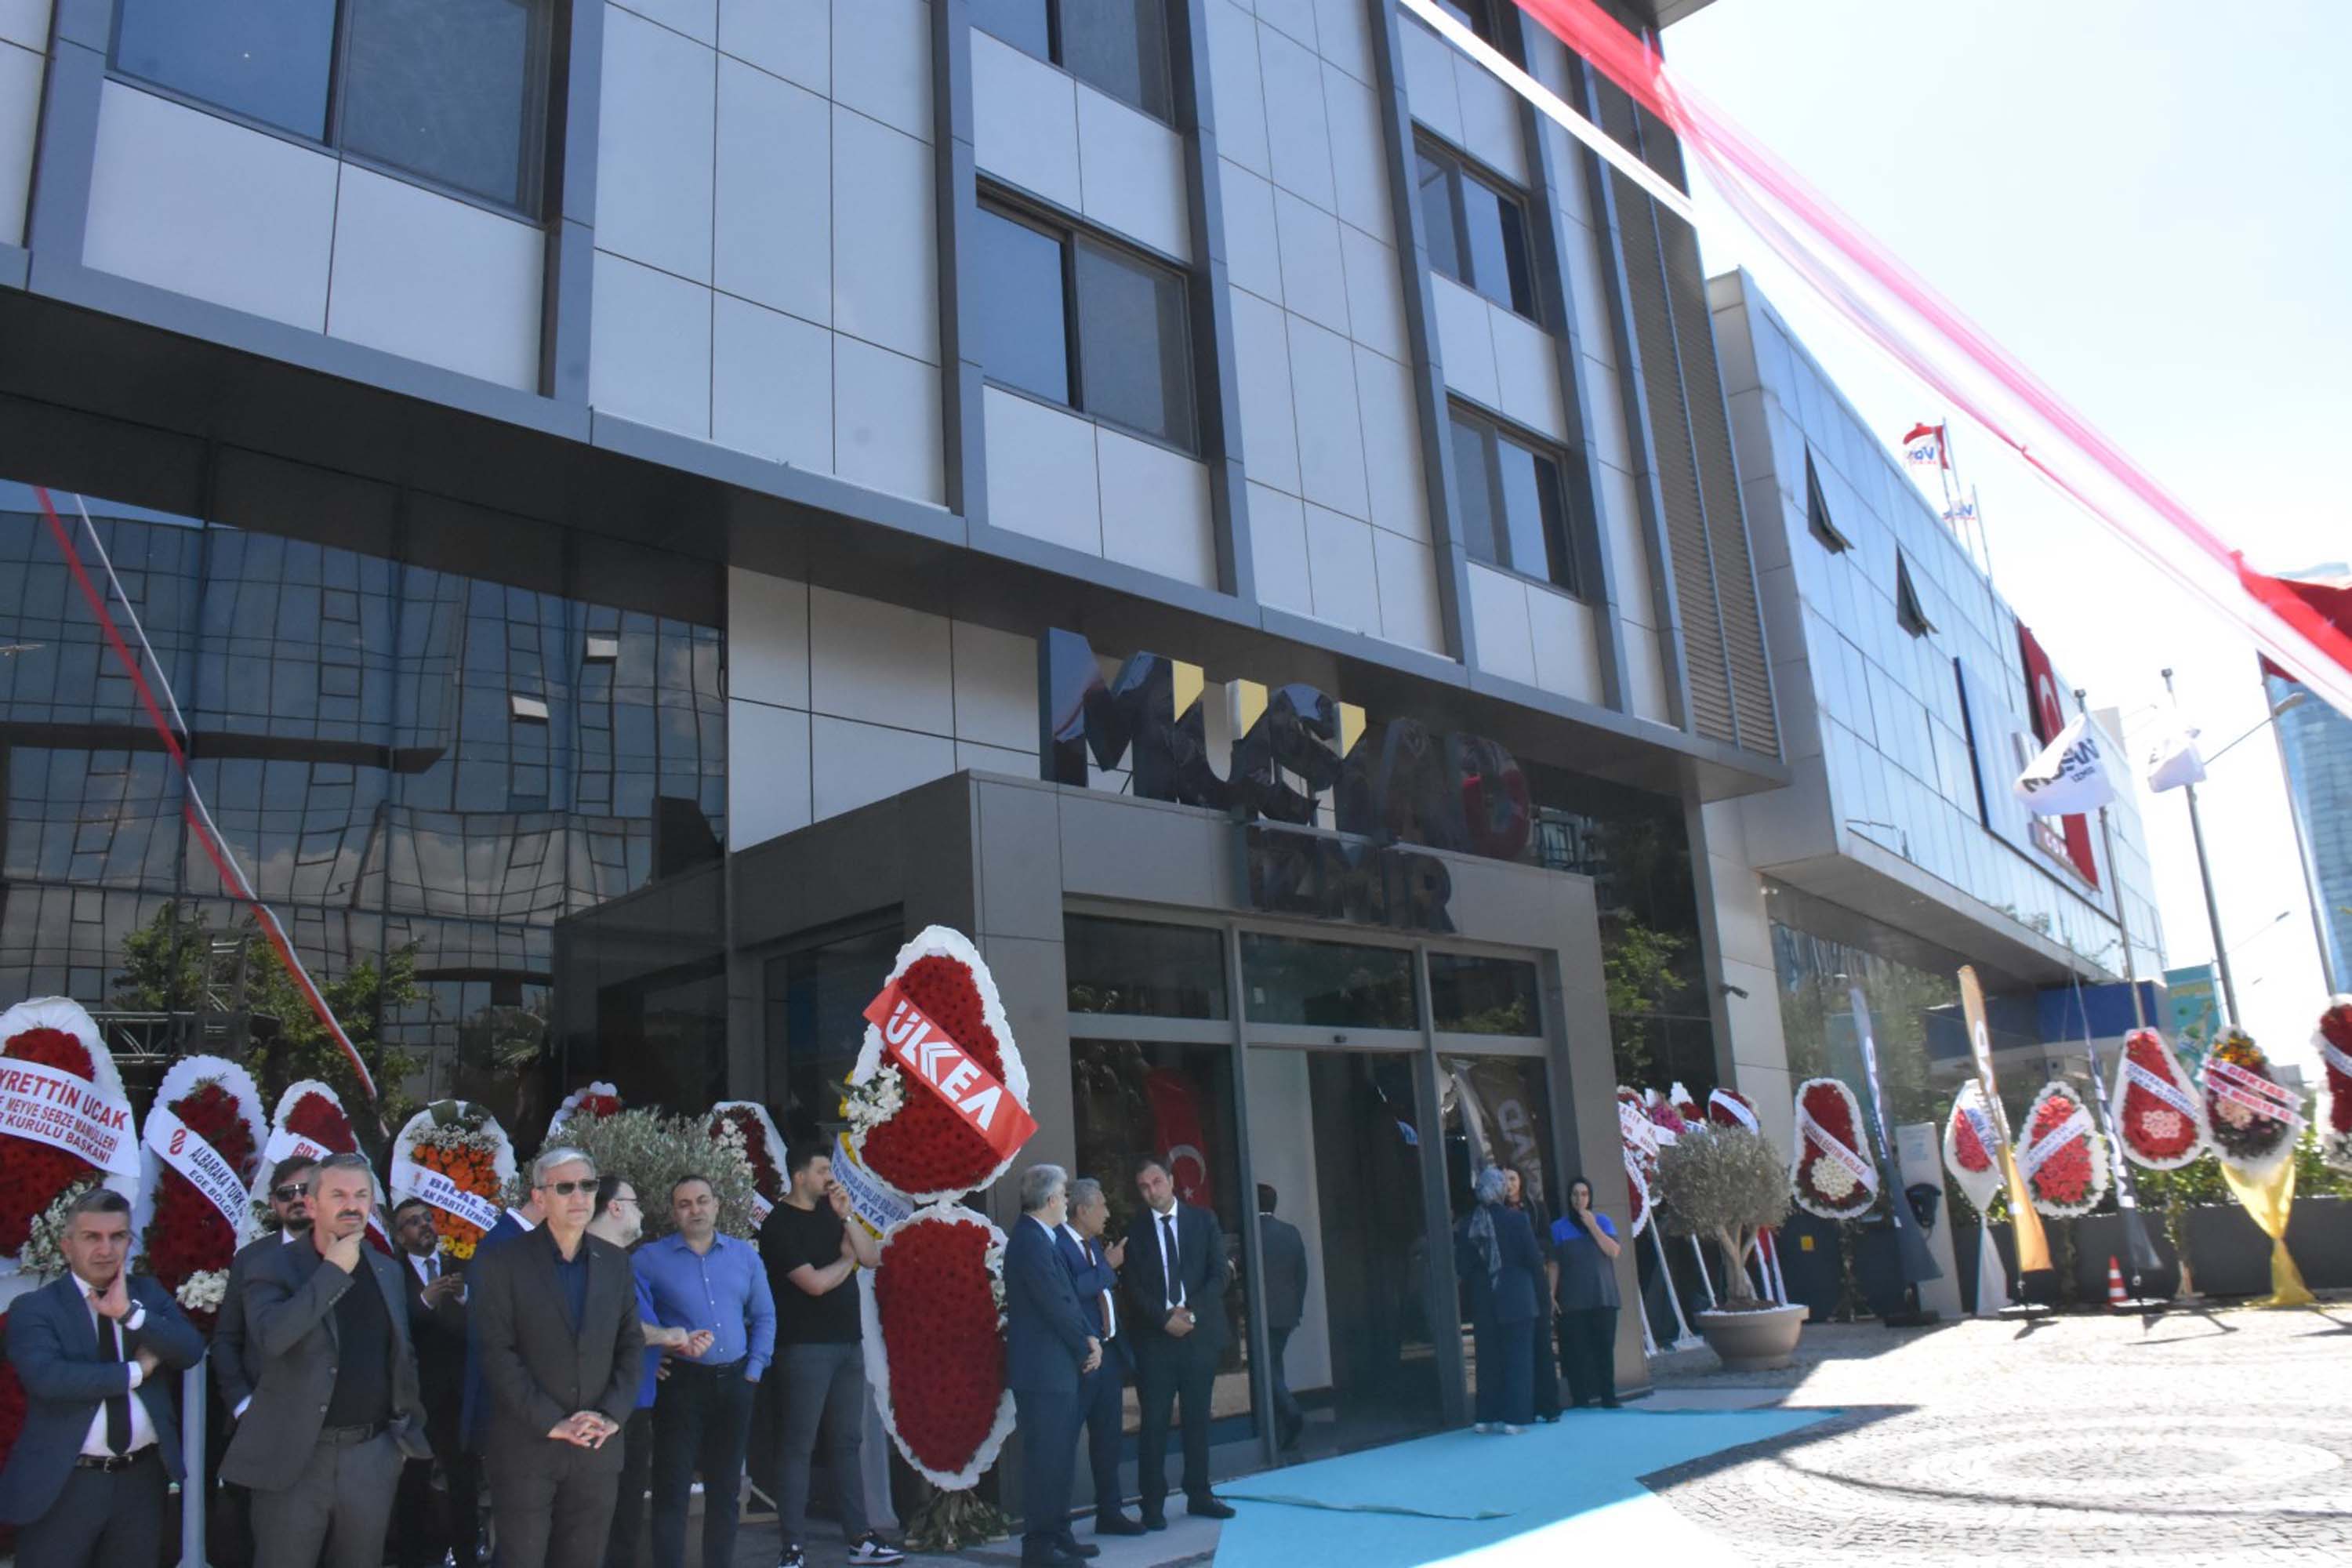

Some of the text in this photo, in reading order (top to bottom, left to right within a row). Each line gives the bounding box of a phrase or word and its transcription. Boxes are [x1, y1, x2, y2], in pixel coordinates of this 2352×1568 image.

[5, 1097, 41, 1117] MEYVE
[41, 1106, 74, 1128] SEBZE
[5, 1112, 64, 1138] KURULU
[188, 1146, 230, 1189] ALBARAKA
[188, 1169, 210, 1189] EGE
[422, 1189, 437, 1202] AK
[858, 1203, 885, 1227] ATA
